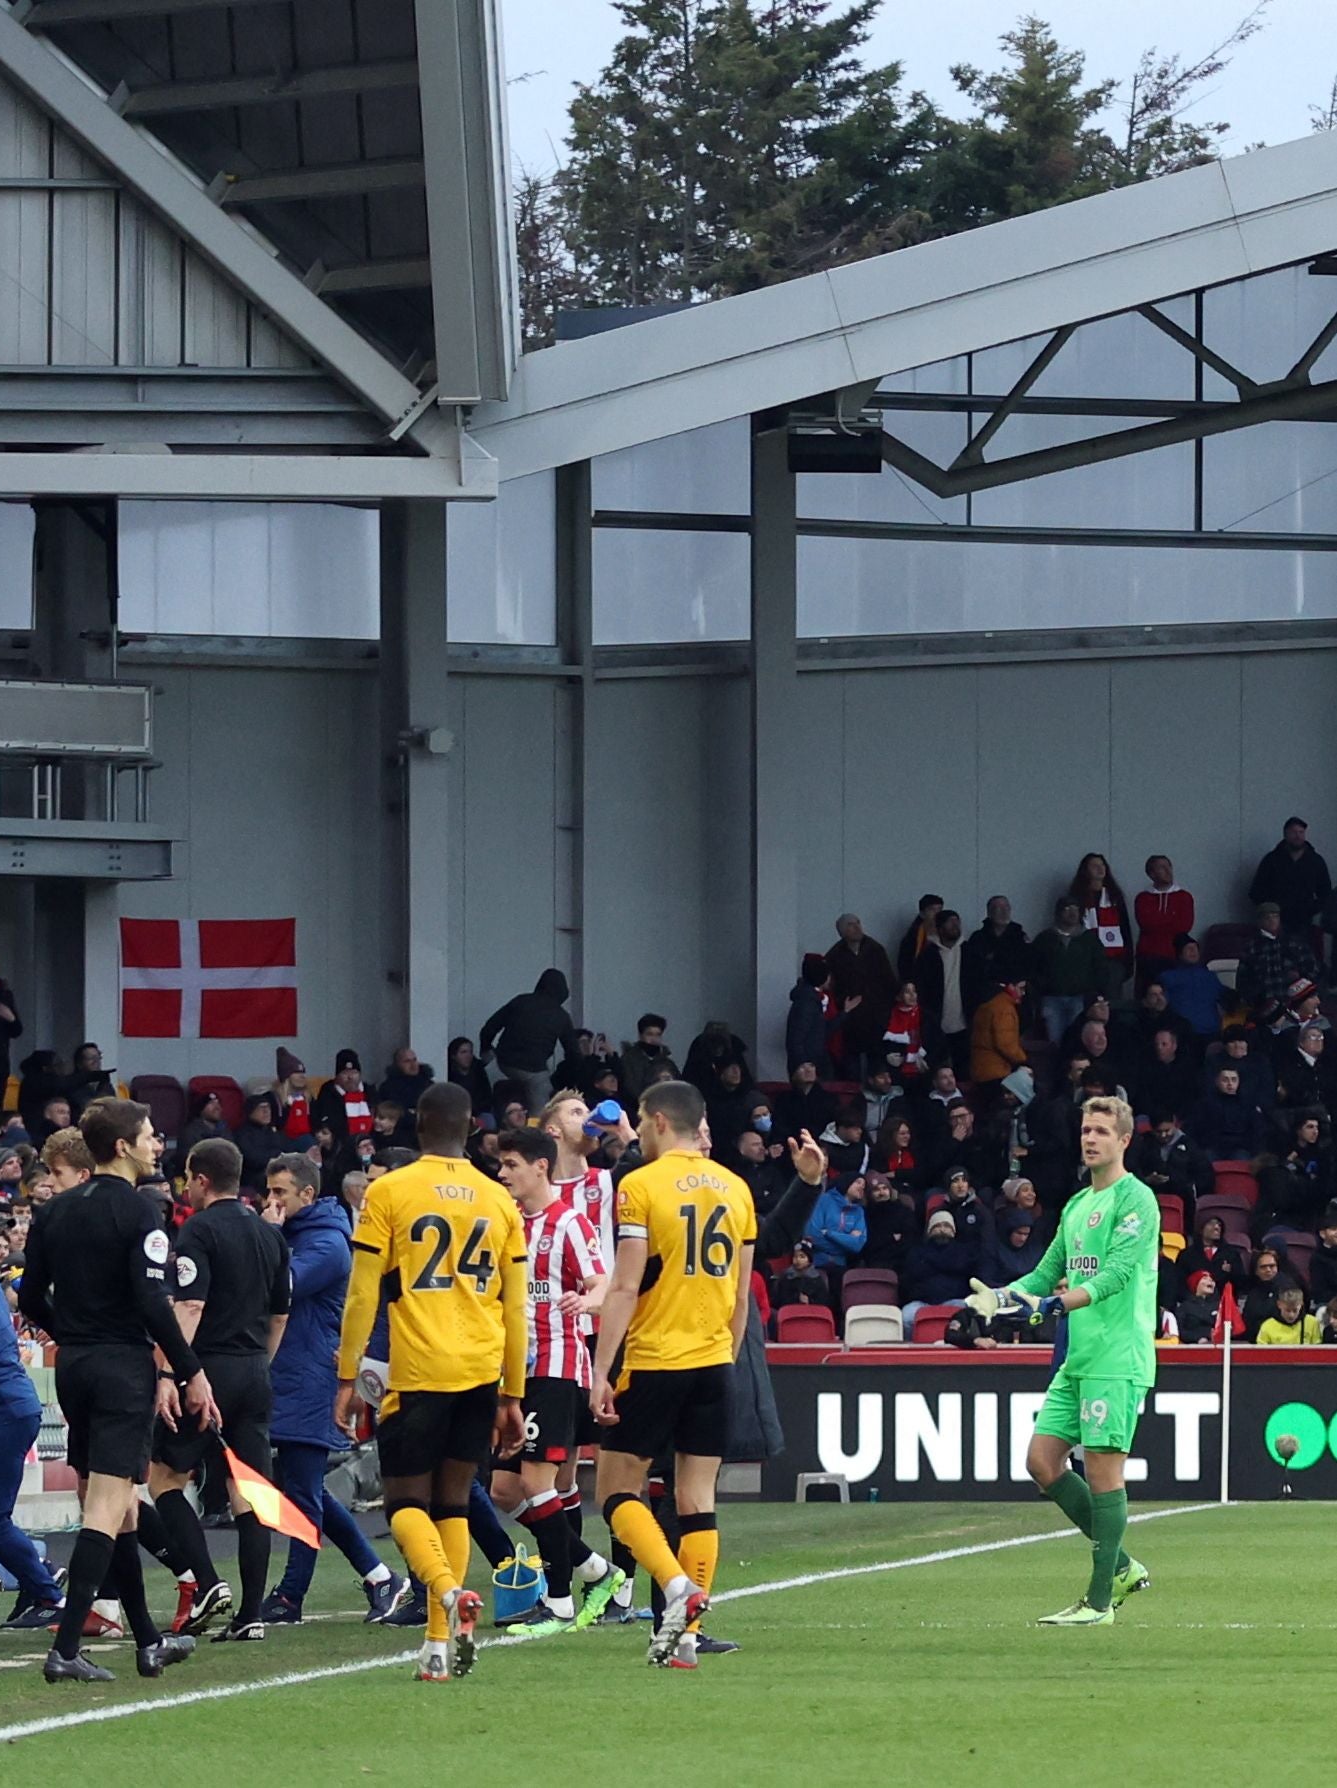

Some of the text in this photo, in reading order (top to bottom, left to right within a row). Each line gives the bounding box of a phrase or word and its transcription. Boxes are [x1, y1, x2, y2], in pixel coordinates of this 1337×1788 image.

[434, 1185, 474, 1203] TOTI
[676, 1174, 729, 1193] COADY
[410, 1214, 494, 1293] 24
[680, 1204, 734, 1277] 16
[1080, 1398, 1107, 1427] 49
